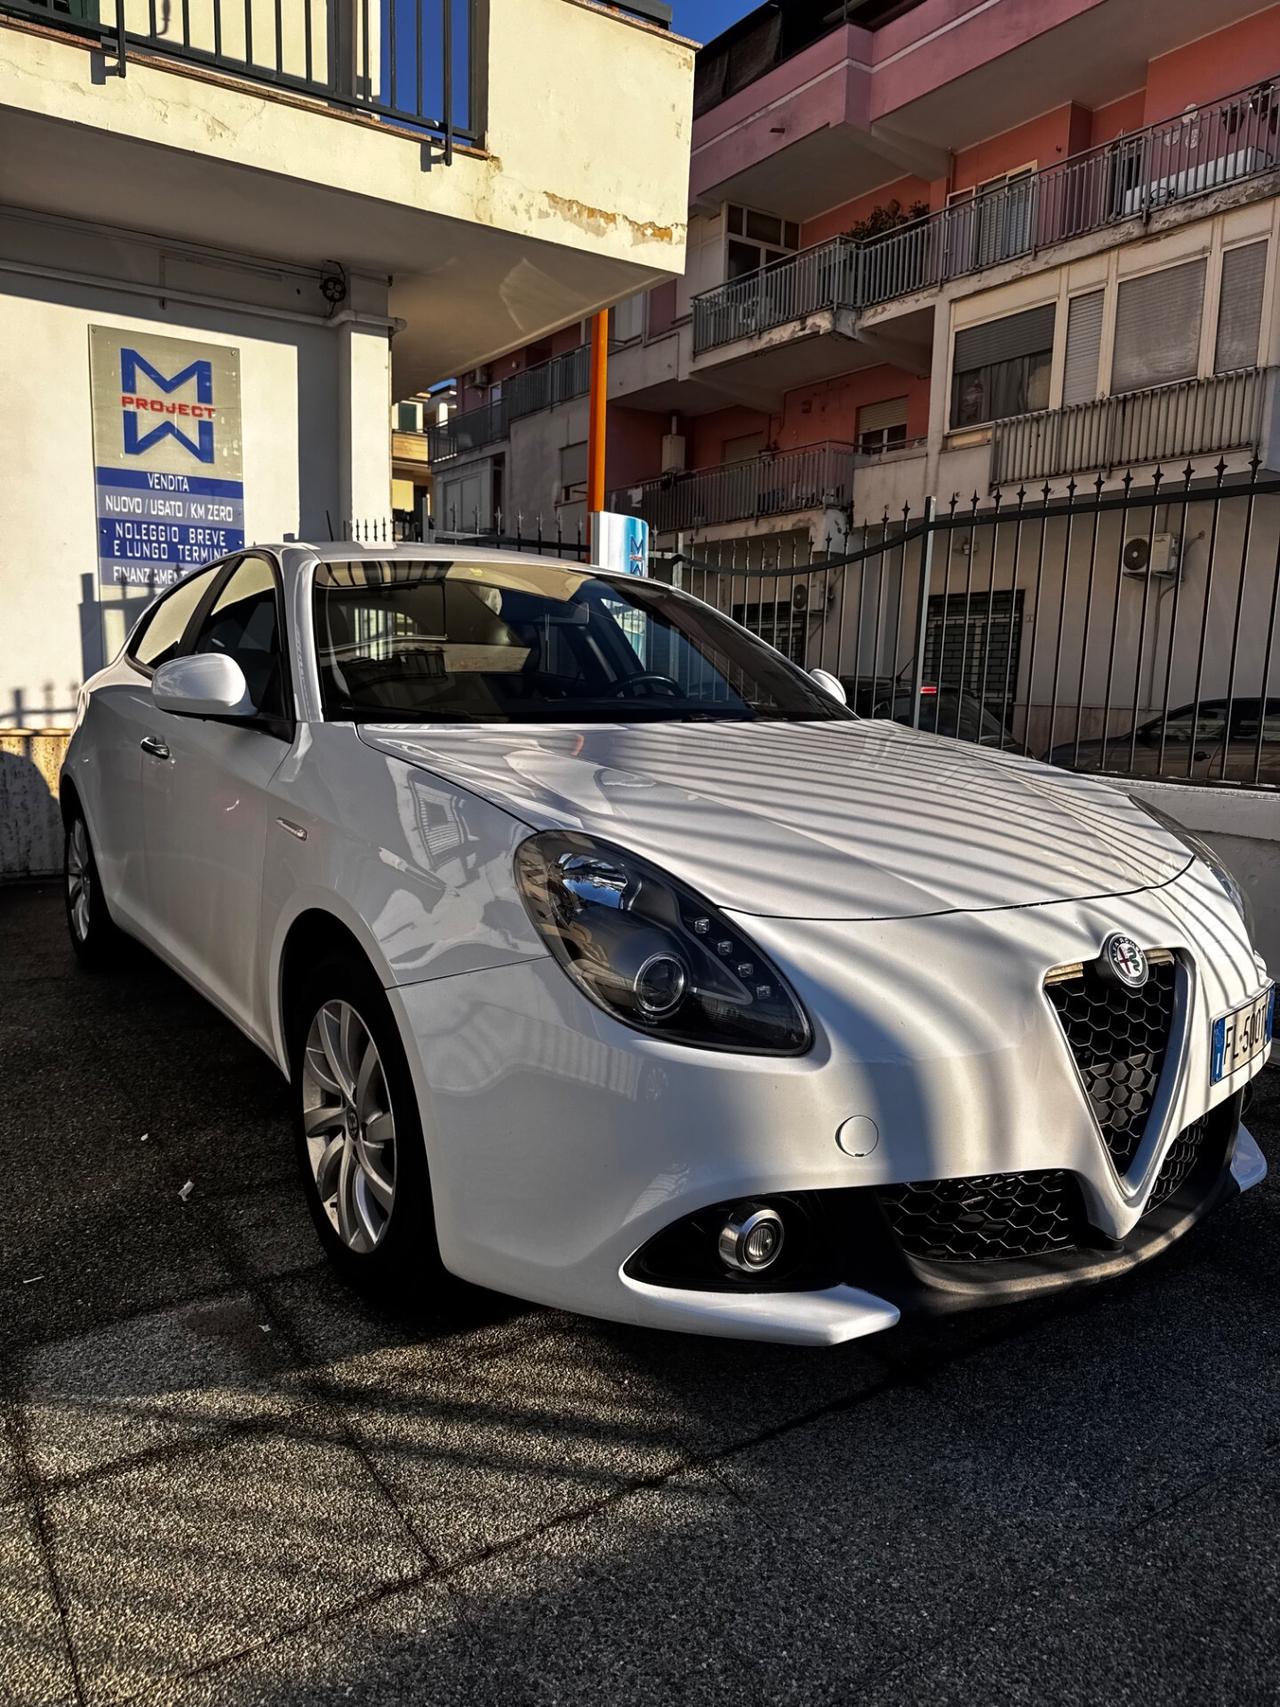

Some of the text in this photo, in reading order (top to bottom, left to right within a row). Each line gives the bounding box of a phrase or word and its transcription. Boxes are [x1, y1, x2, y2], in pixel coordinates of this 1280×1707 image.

[121, 396, 216, 419] PROJECT
[147, 473, 190, 492] VENDITA
[105, 495, 142, 513] NUOVO
[150, 499, 183, 517] USATO
[190, 503, 205, 519] KM
[208, 504, 233, 522] ZERO
[115, 522, 226, 546] NOLEGGIO BREVE
[113, 540, 121, 556] E
[126, 541, 168, 559] LUNGO
[113, 565, 189, 585] FINANZAMEN
